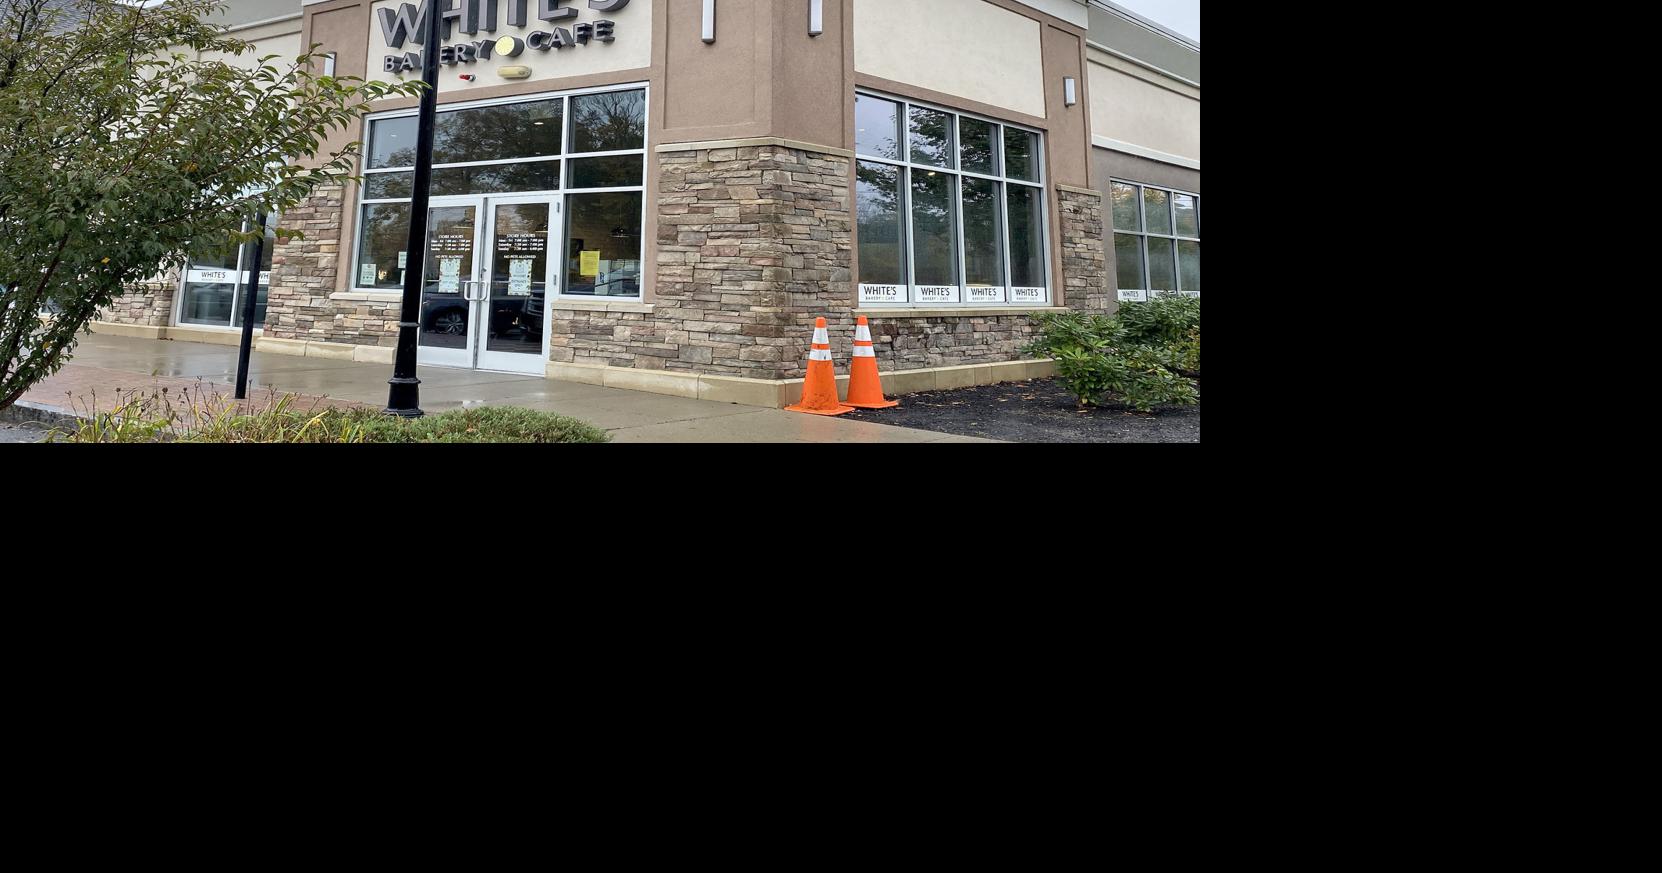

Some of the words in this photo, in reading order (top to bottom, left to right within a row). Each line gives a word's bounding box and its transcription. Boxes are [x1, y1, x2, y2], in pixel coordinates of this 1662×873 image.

[383, 40, 497, 75] BAERY
[526, 20, 615, 51] CAFE
[864, 286, 897, 295] WHITE'S
[921, 287, 950, 296] WHITE'S
[970, 288, 997, 296] WHITE'S
[1015, 288, 1039, 296] WHITE'S
